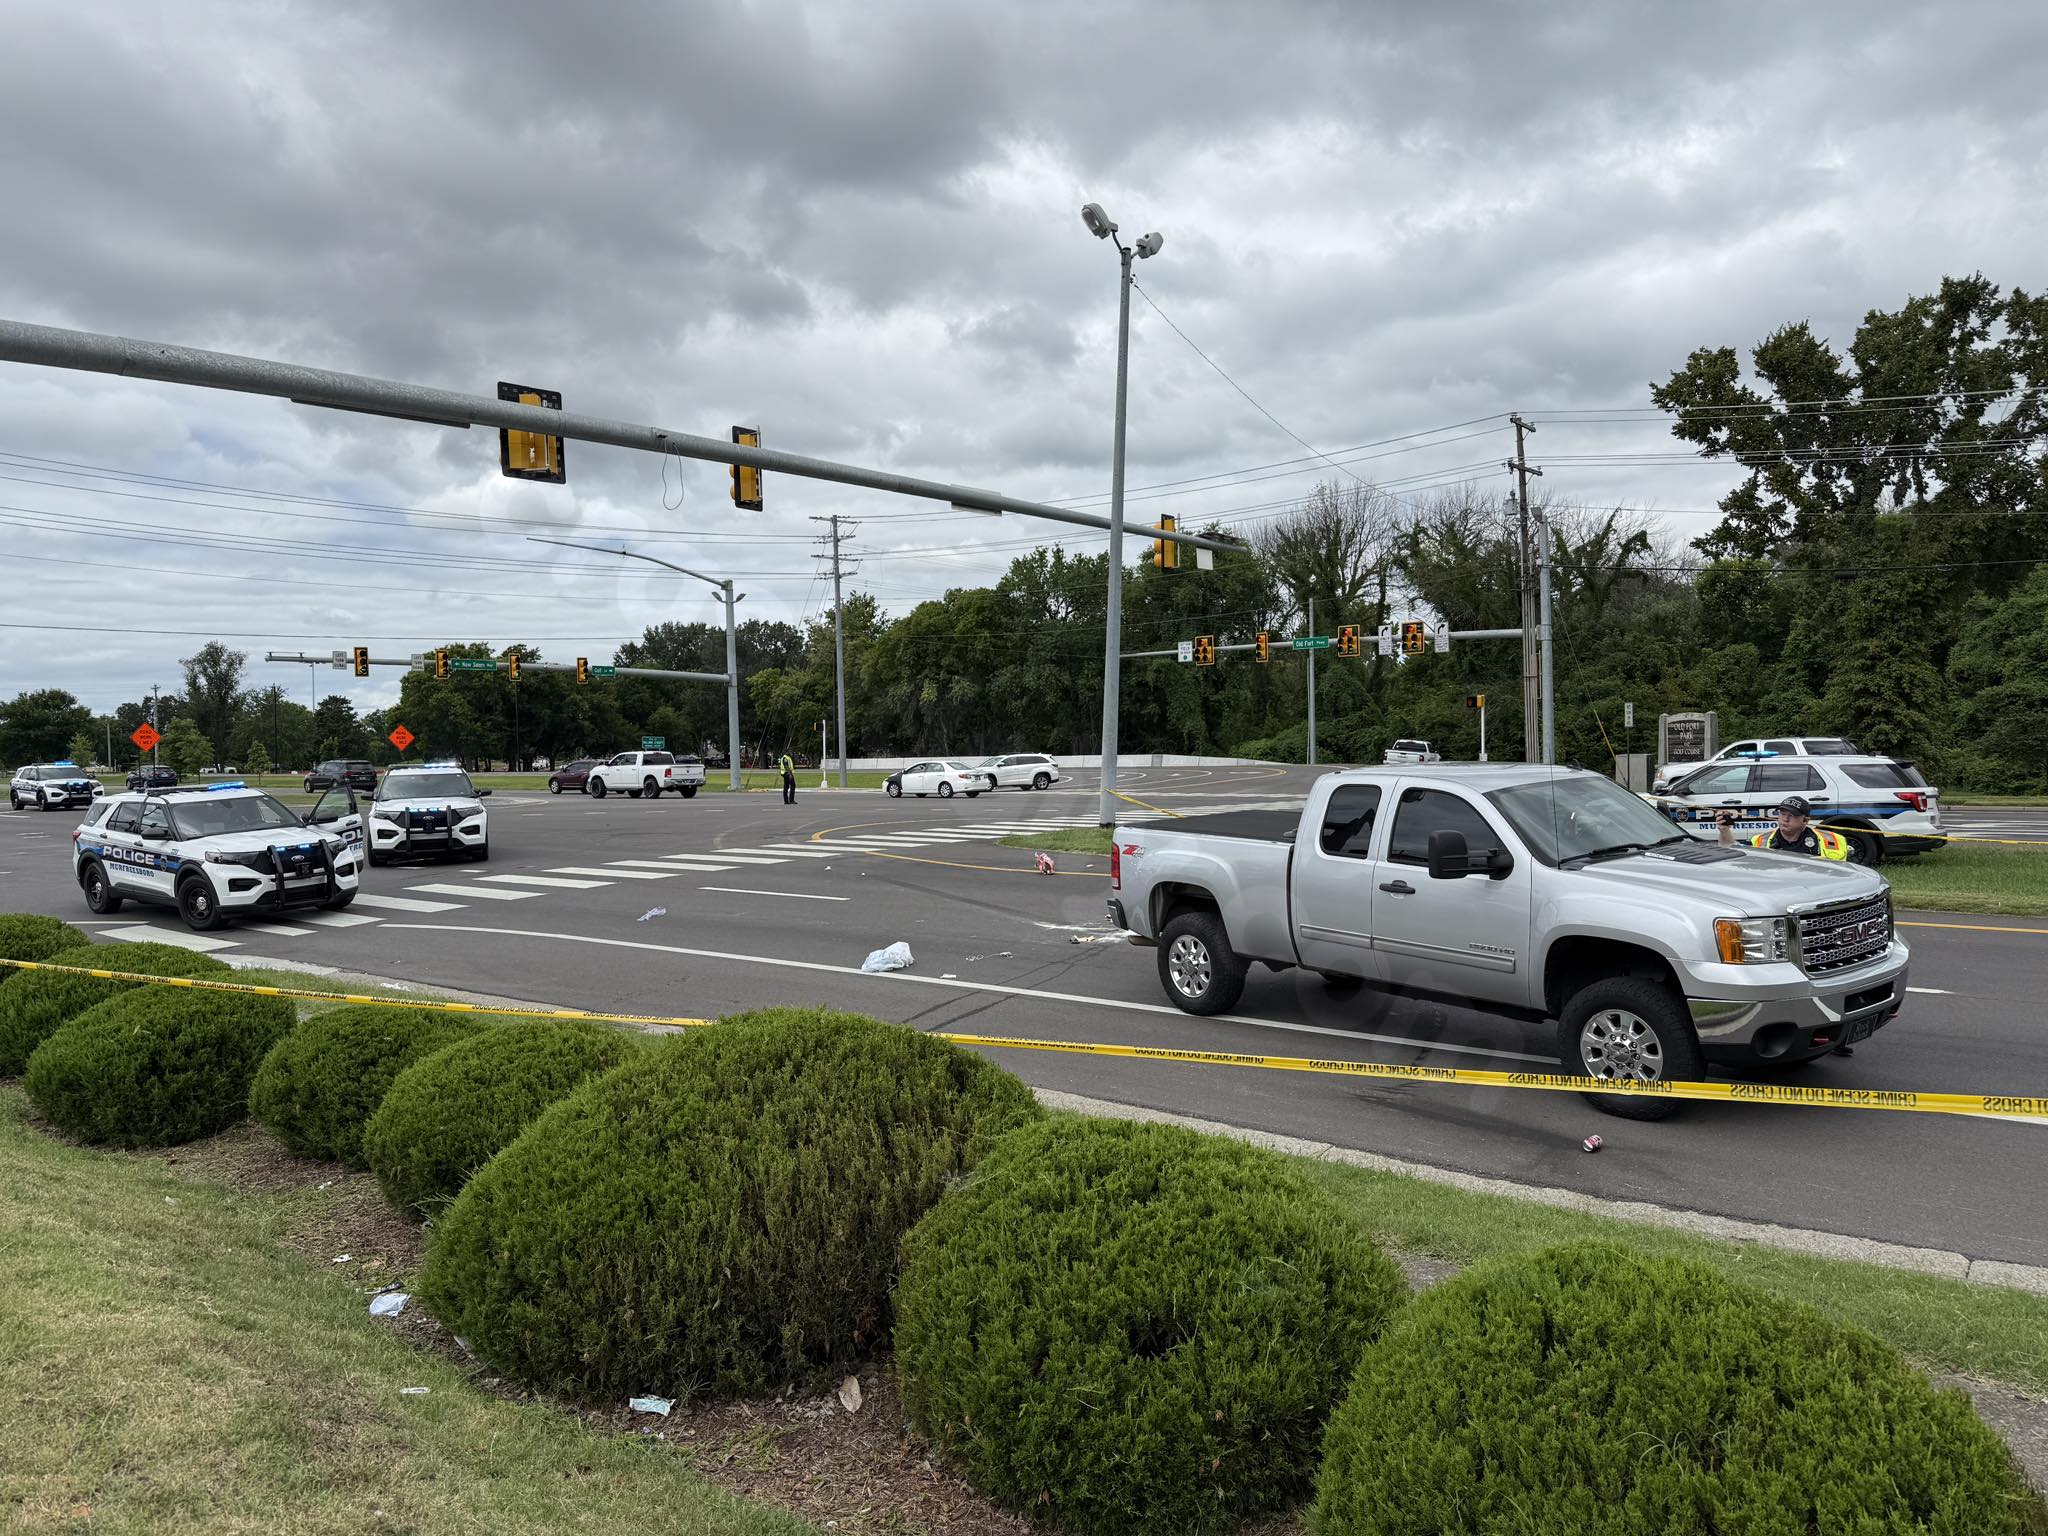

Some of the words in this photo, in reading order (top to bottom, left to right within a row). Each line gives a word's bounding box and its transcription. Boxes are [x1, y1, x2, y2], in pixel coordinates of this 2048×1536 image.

[1673, 723, 1686, 731] OLD
[1686, 722, 1699, 730] FORT
[1680, 732, 1693, 740] PARK
[1695, 808, 1780, 820] PLIC
[1699, 822, 1778, 830] MUREESBO
[103, 845, 155, 865] POLICE
[109, 862, 155, 878] MURFREESBORO
[1838, 920, 1881, 945] GMC
